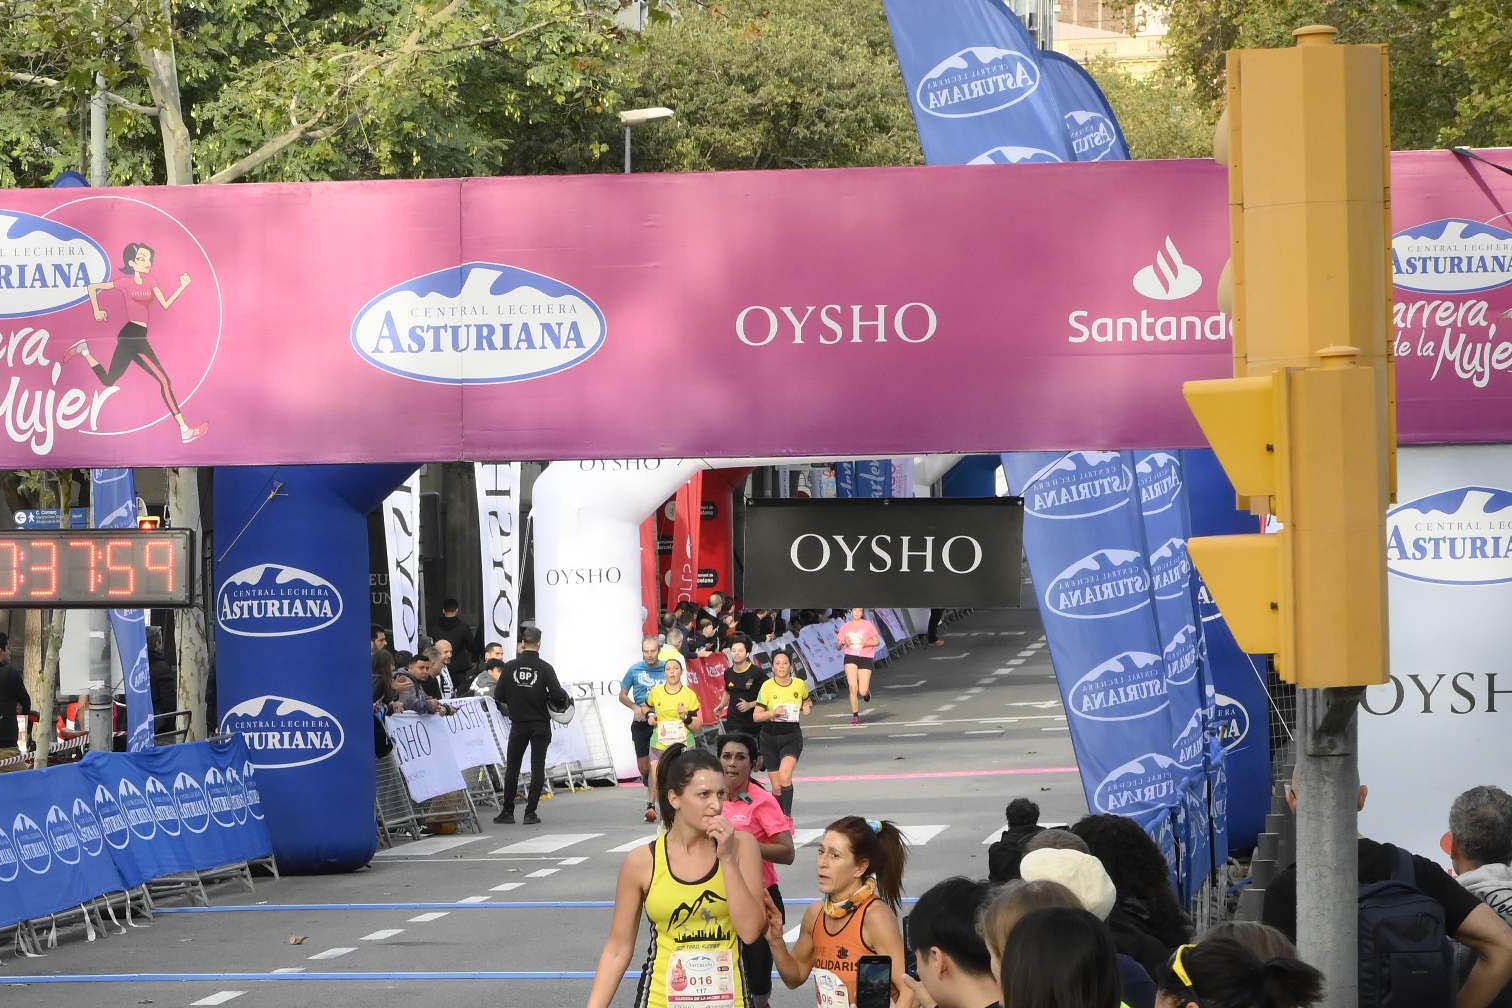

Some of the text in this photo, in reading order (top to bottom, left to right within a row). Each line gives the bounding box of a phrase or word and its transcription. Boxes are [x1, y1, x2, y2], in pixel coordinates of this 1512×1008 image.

[13, 246, 86, 258] LECHERA
[410, 303, 578, 318] CENTRAL LECHERA
[1393, 300, 1488, 328] arrera
[371, 309, 587, 355] ASTURIANA
[735, 302, 938, 346] OYSHO
[1068, 311, 1233, 343] Santand
[1417, 329, 1435, 356] la
[1430, 324, 1512, 388] Muje
[1414, 522, 1482, 532] CENTRAL
[790, 533, 983, 574] OYSHO
[1387, 525, 1512, 561] ASTURI
[546, 566, 622, 586] OYSHO
[233, 588, 328, 598] CENTRAL LECHERA
[221, 593, 333, 621] ASTURIANA
[519, 671, 532, 681] BP
[577, 680, 621, 697] SHO
[1364, 672, 1512, 716] OYSH
[226, 724, 335, 750] TURIANA
[235, 720, 330, 730] CENTRAL LECHERA
[690, 975, 713, 986] 016
